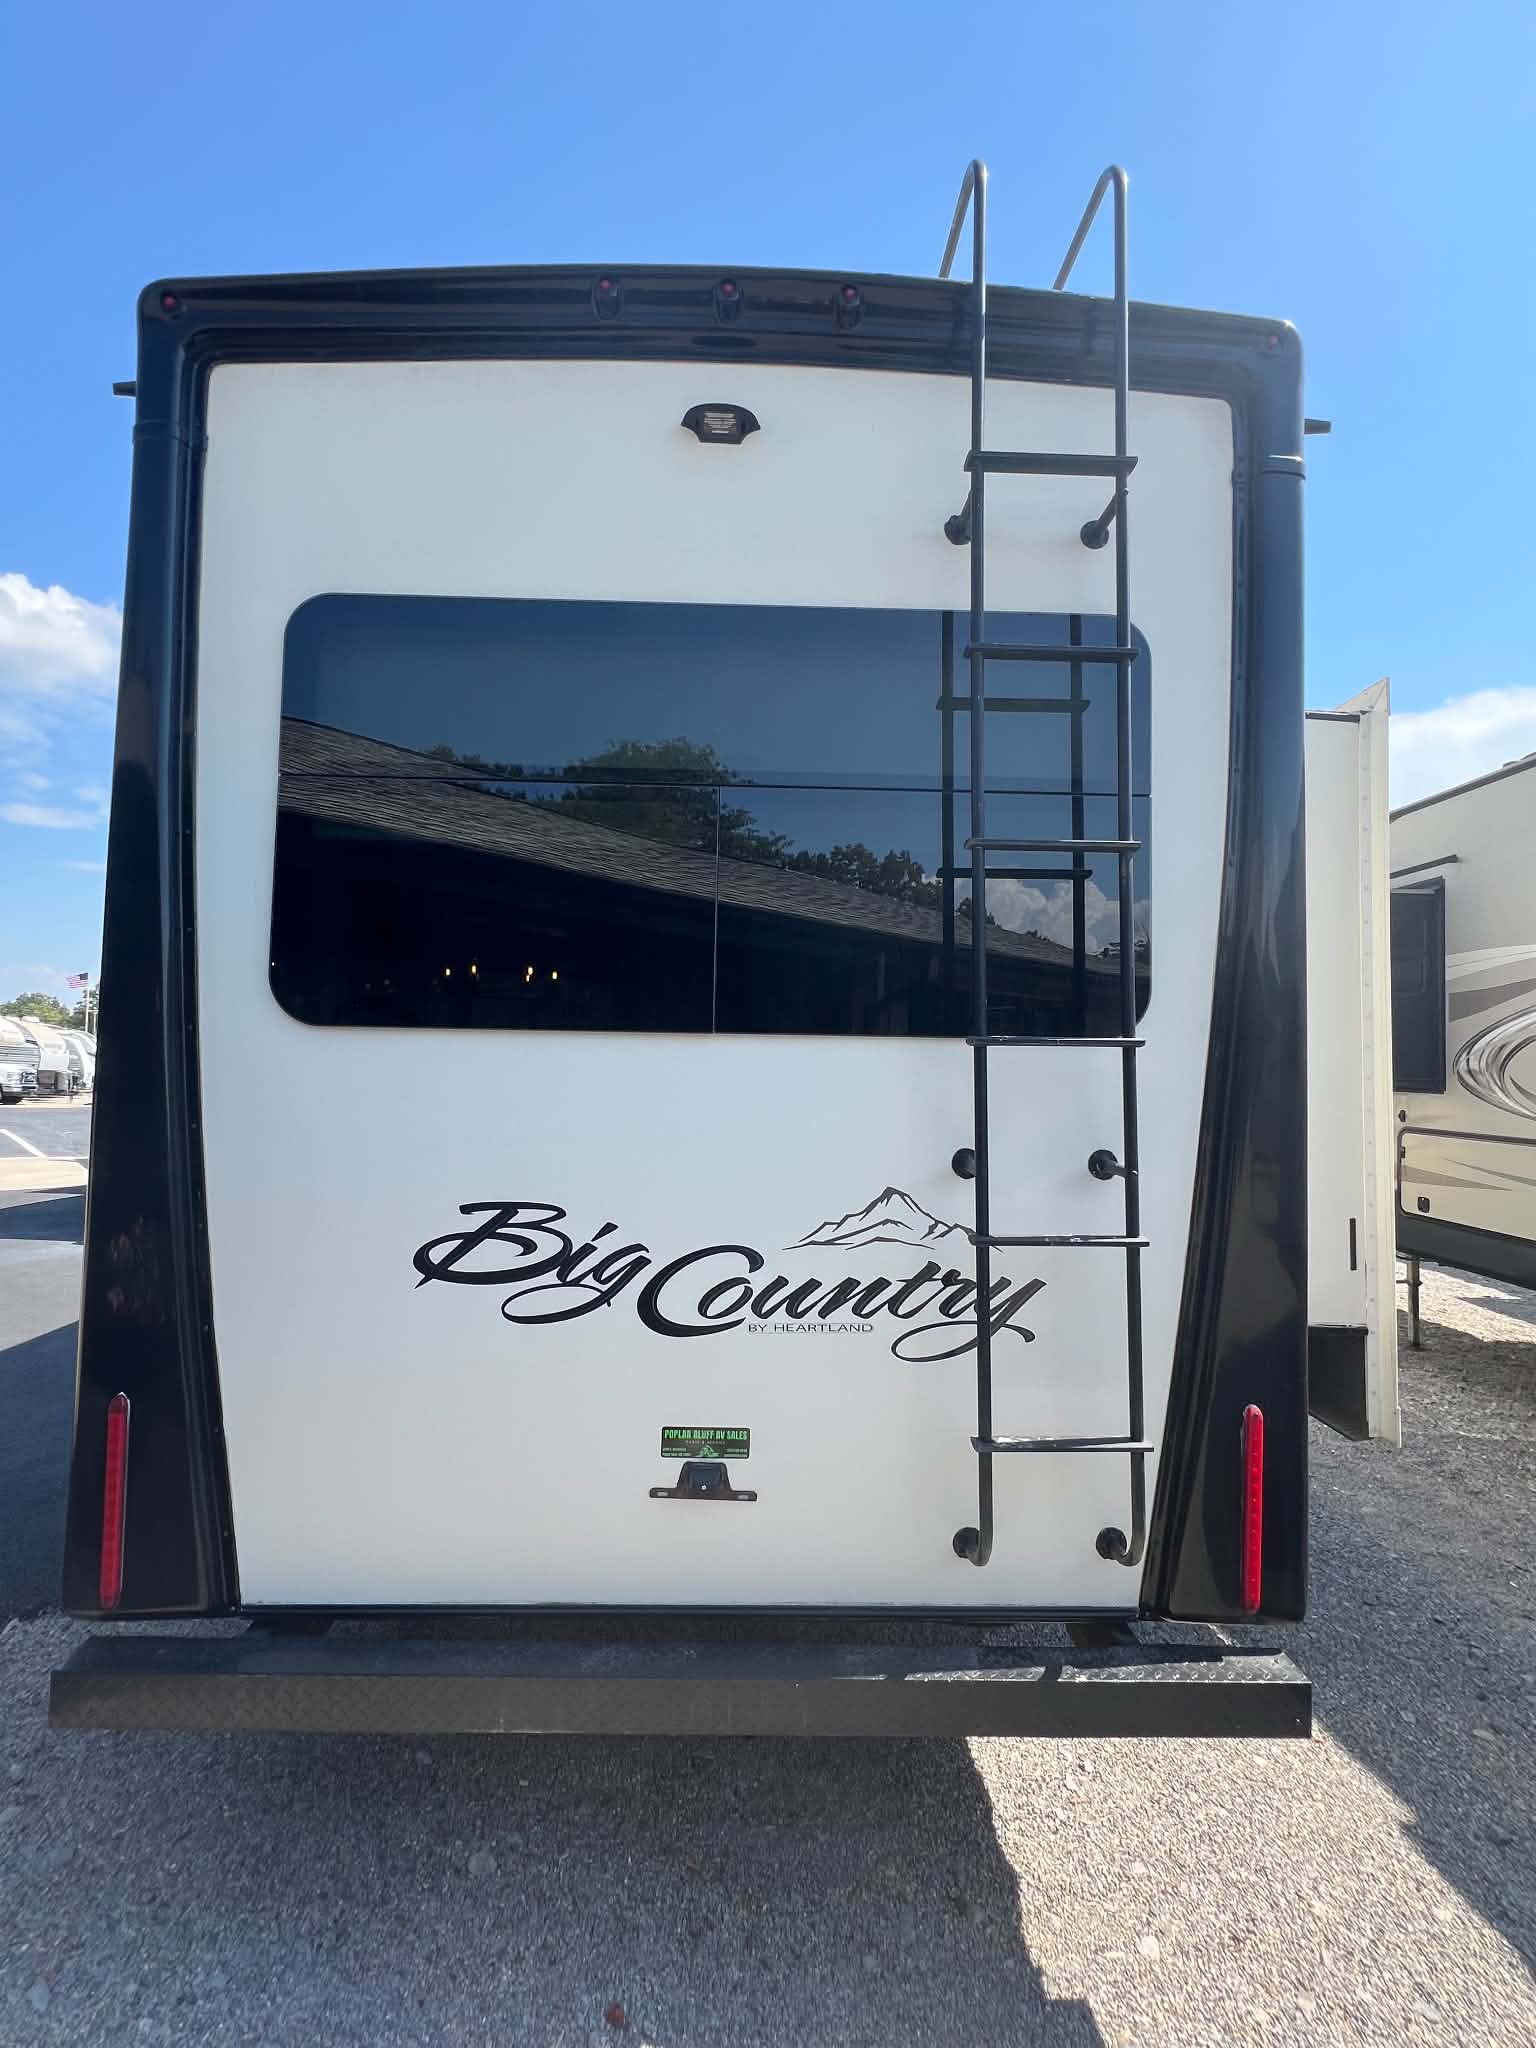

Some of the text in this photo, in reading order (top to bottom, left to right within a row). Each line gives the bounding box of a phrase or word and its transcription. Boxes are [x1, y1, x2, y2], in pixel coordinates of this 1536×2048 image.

[413, 1201, 1047, 1363] Big Country
[748, 1323, 873, 1333] BY HEARTLAND
[664, 1429, 748, 1441] POPLAR BLUFF RV SALES
